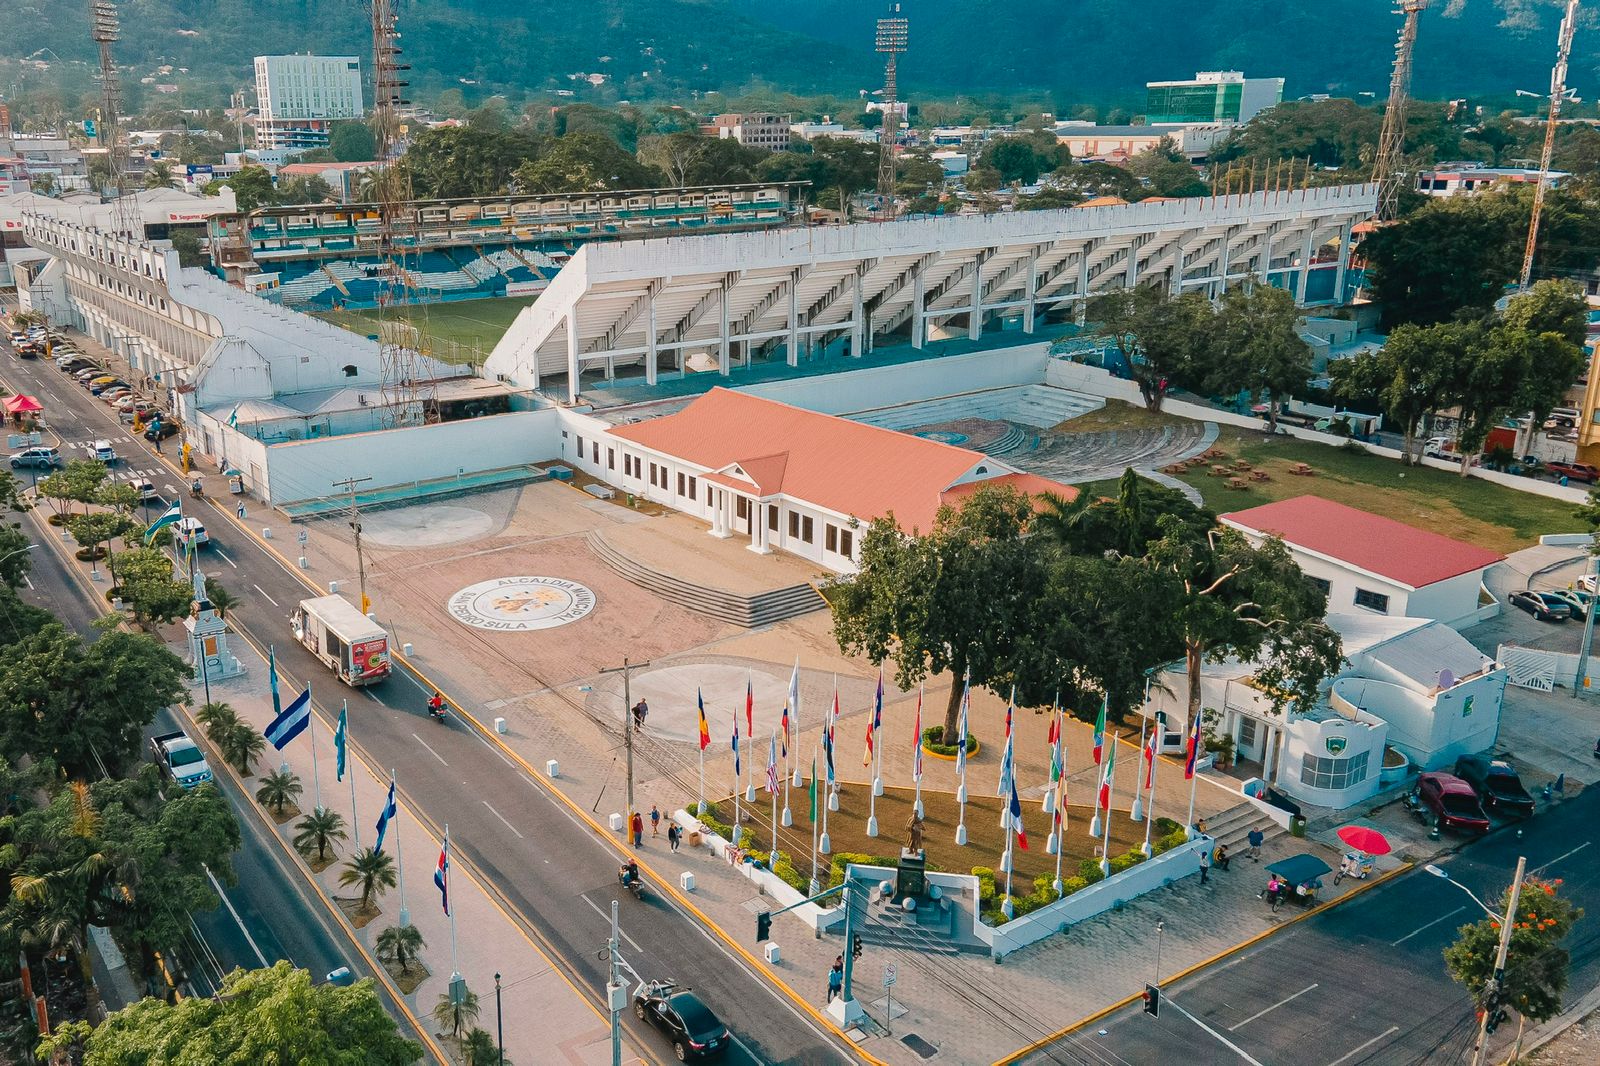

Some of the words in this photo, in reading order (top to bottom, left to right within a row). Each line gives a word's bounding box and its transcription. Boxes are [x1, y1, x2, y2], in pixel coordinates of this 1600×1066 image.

[25, 225, 75, 250] ESTADIO
[89, 245, 165, 281] GENERAL
[454, 592, 476, 604] SAN
[498, 578, 574, 589] ALCALDIA
[553, 587, 591, 621] MUNICIPAL
[454, 605, 484, 625] PEDRO
[484, 620, 528, 629] SULA
